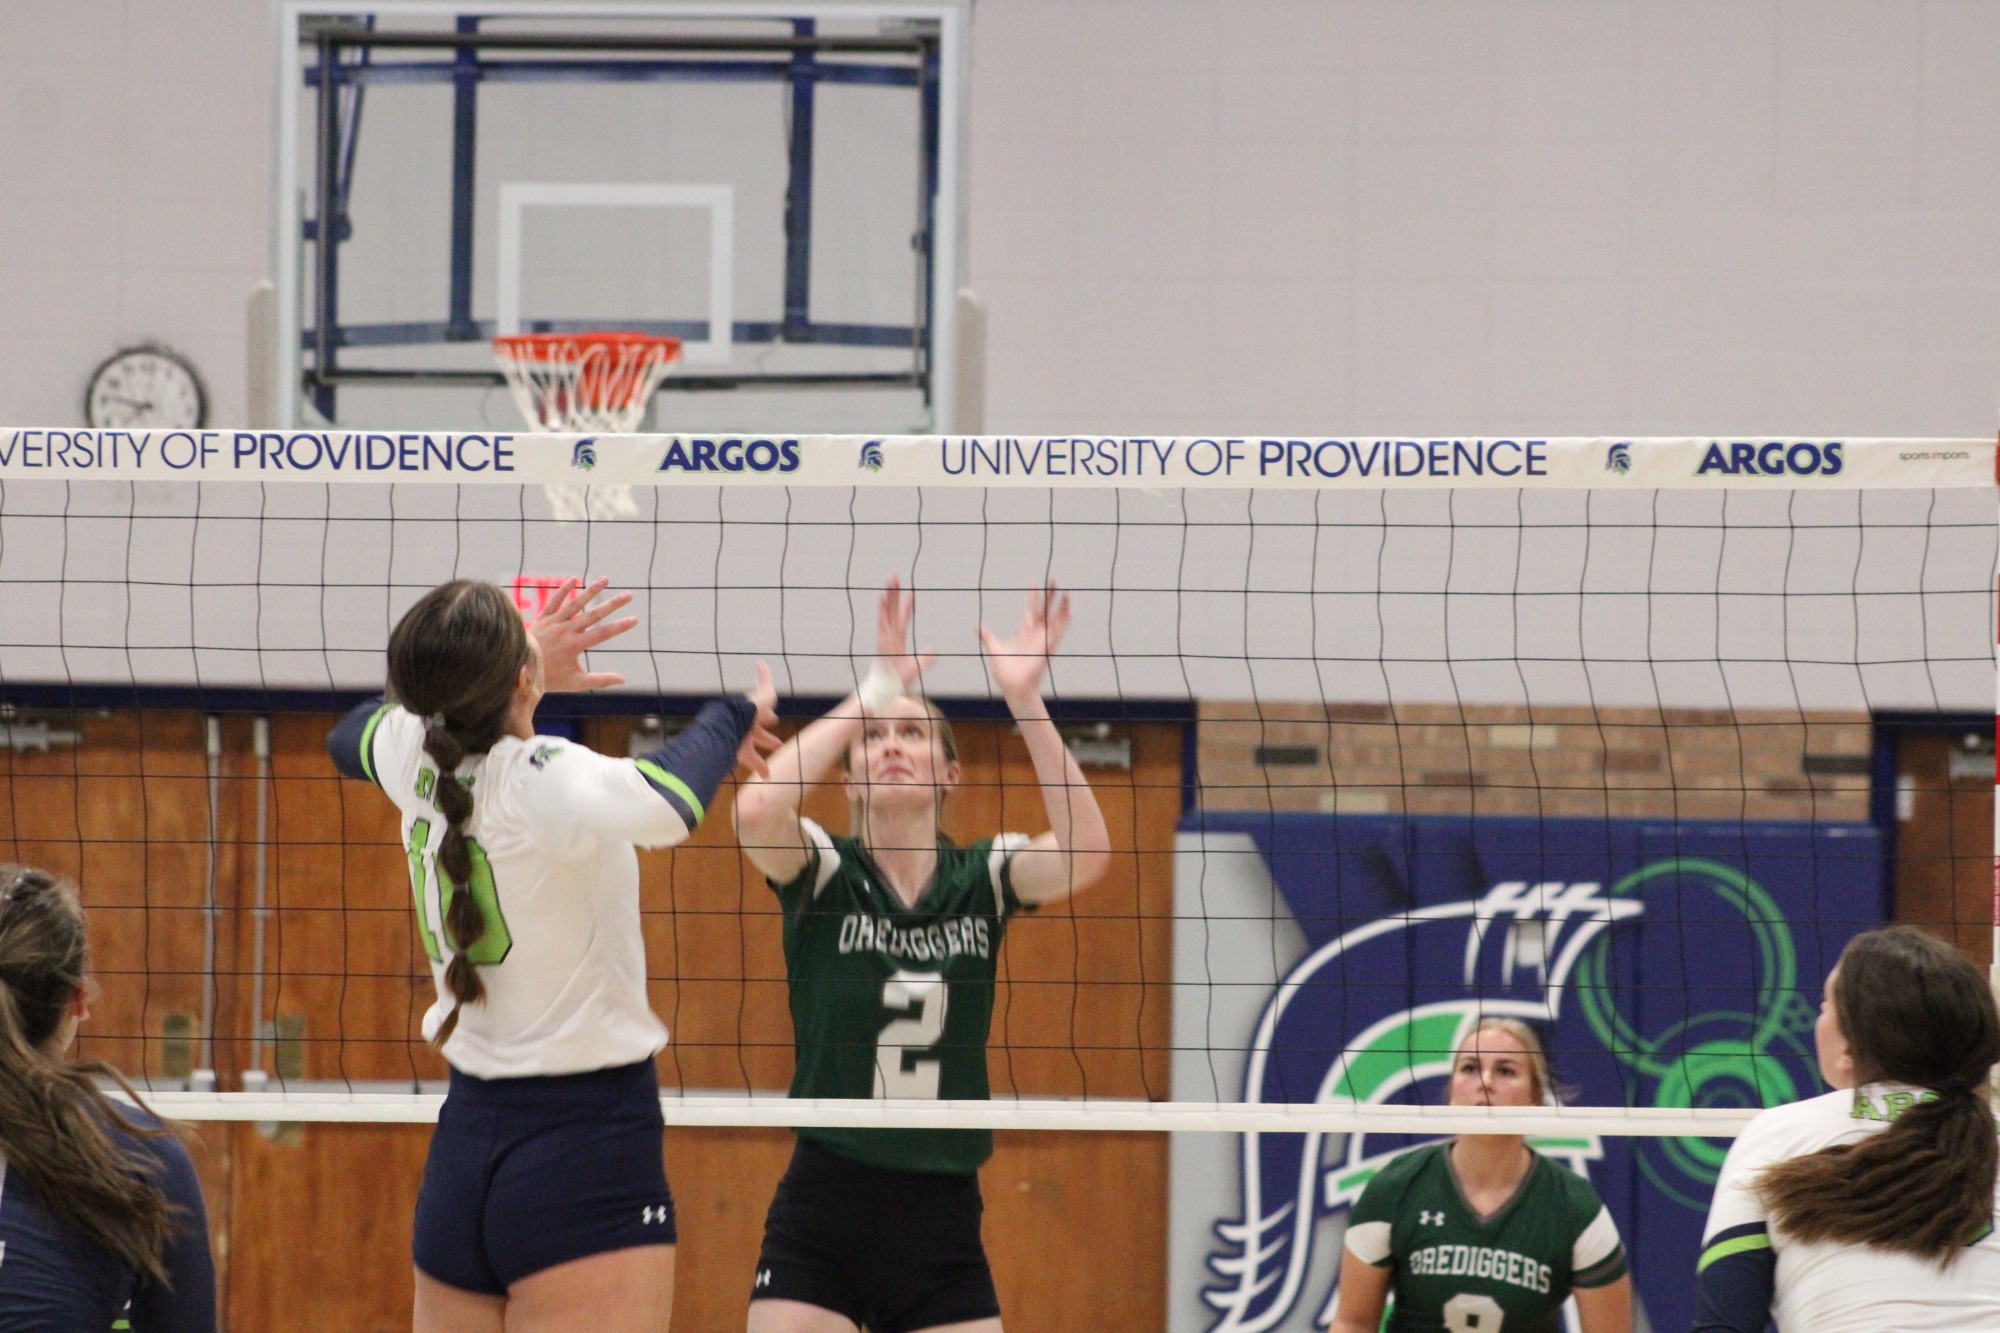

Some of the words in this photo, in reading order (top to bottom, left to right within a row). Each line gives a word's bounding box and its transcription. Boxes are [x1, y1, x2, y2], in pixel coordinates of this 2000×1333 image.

[0, 431, 151, 468] VERSITY
[160, 432, 219, 469] OF
[233, 433, 514, 471] PROVIDENCE
[657, 438, 801, 473] ARGOS
[942, 438, 1176, 475] UNIVERSITY
[1185, 439, 1245, 476] OF
[1260, 440, 1547, 478] PROVIDENCE
[1694, 441, 1843, 476] ARGOS
[872, 969, 949, 1100] 2
[1409, 1245, 1552, 1294] OREDIGGERS
